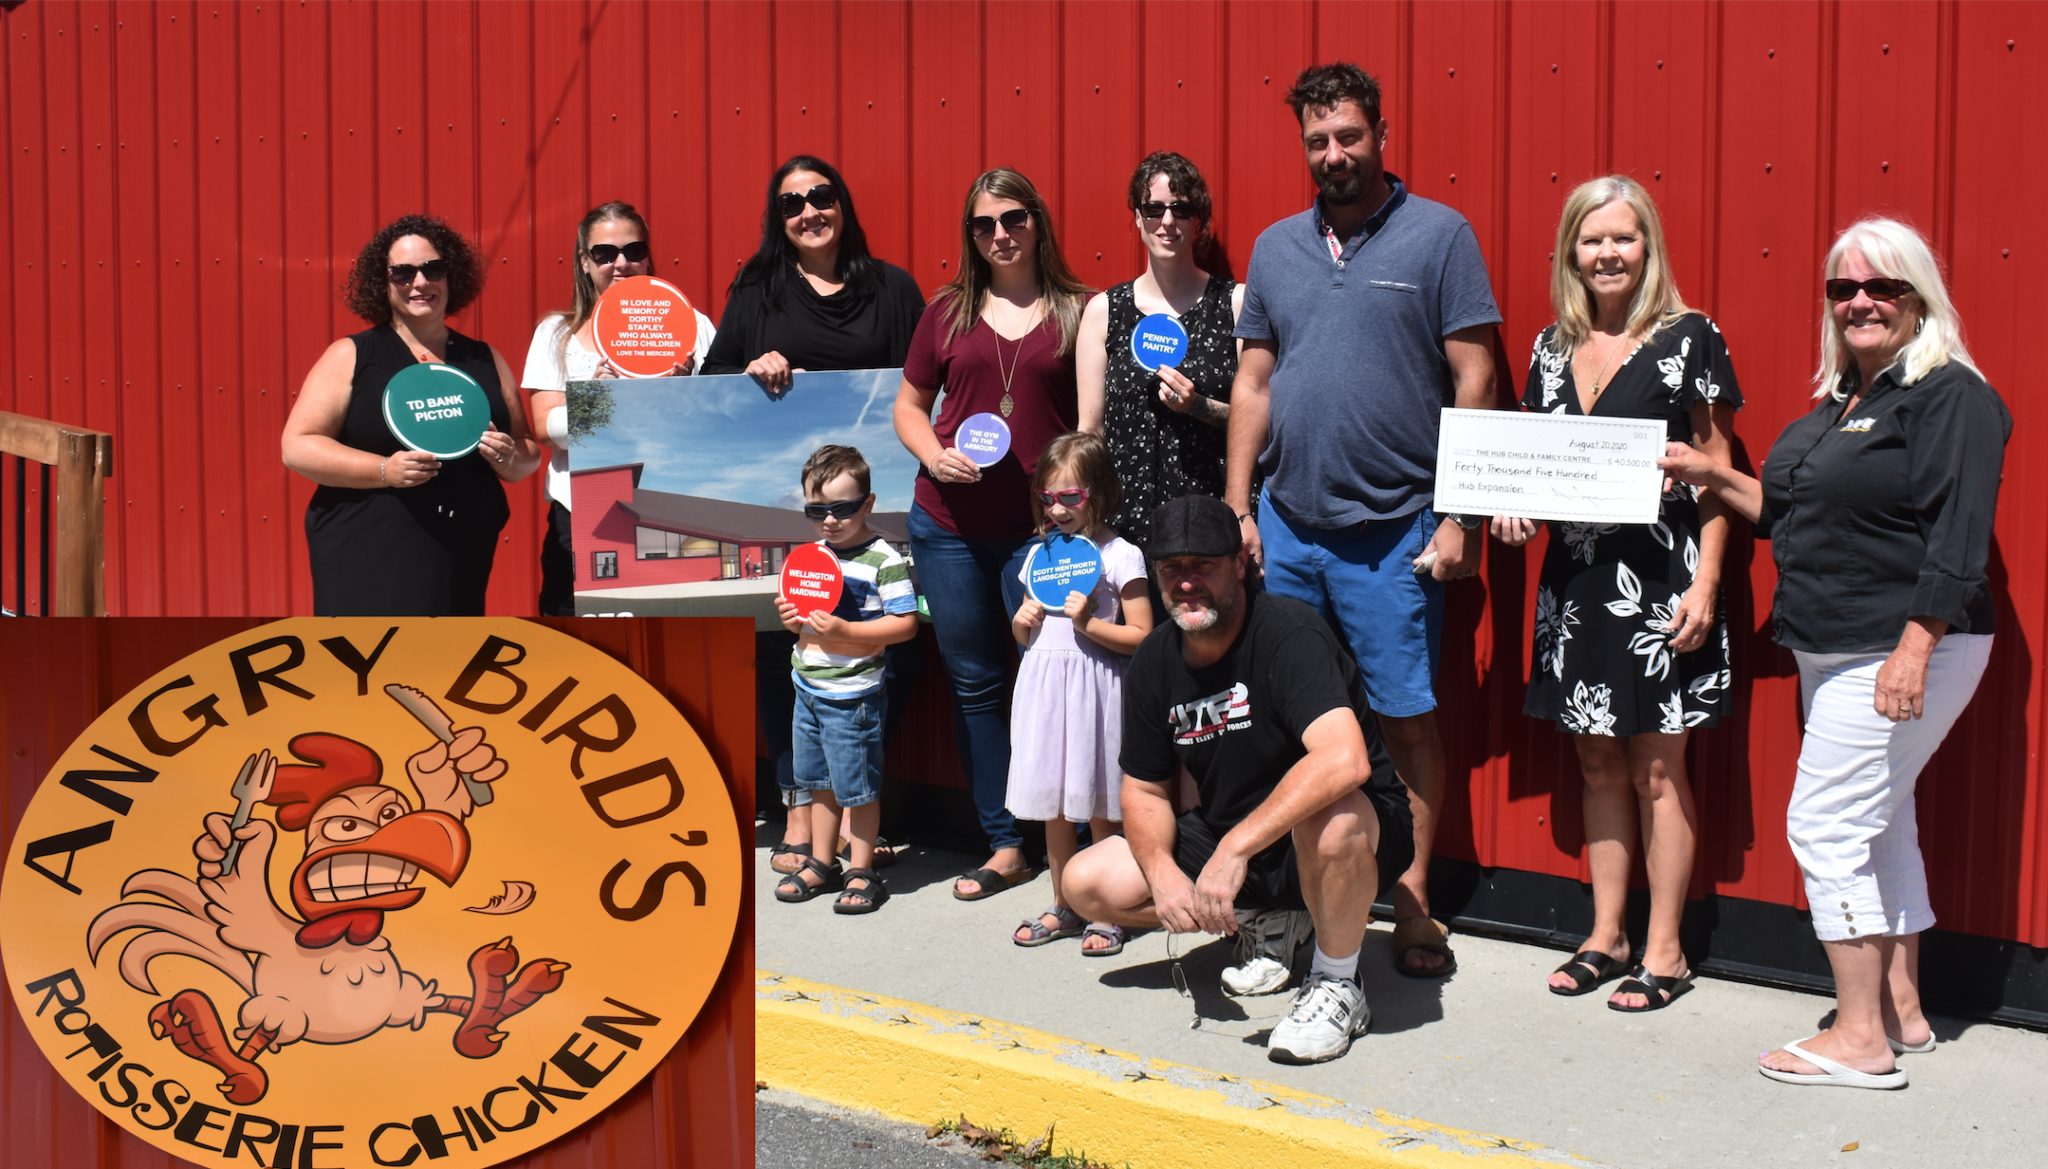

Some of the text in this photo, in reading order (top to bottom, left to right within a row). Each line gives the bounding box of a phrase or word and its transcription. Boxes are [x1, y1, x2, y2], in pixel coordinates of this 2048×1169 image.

[1142, 332, 1179, 346] PENNY'S
[1142, 341, 1176, 354] PANTRY
[406, 394, 464, 410] TD BANK
[414, 407, 463, 422] PICTON
[969, 429, 983, 437] THE
[964, 443, 998, 453] ARMOURY
[1569, 439, 1599, 452] August
[1536, 453, 1561, 461] FAMILY
[1607, 458, 1613, 466] $
[1455, 461, 1598, 480] Forty Thousand Five Hundred
[1459, 481, 1524, 494] Hub Expansion
[1033, 561, 1096, 576] SCOTT WENTWORTH
[1033, 567, 1096, 583] LANDSCAPE GROUP
[789, 569, 835, 582] WELLINGTON
[800, 580, 821, 589] HOME
[789, 587, 830, 599] HARDWARE
[1227, 720, 1252, 731] FORCES
[23, 626, 708, 921] ANGRY BIRD'S
[25, 968, 662, 1169] ROTISSERIE CHICKEN
